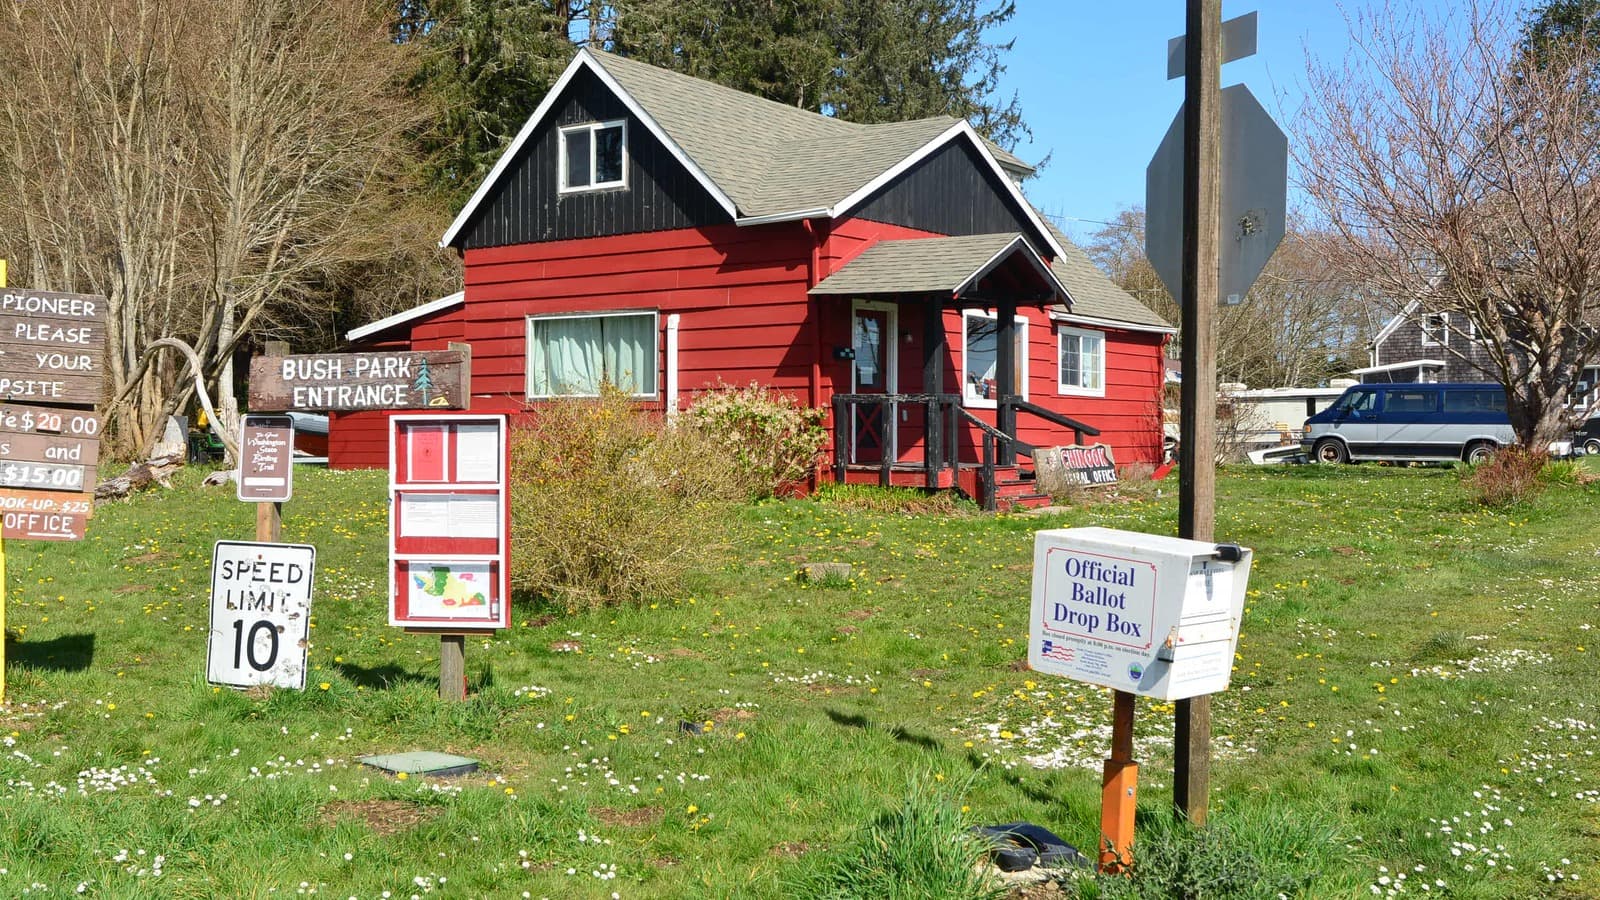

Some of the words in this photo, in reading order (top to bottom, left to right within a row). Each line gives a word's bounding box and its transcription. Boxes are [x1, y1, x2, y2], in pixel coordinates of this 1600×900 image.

[2, 294, 96, 317] PIONEER
[15, 323, 92, 344] PLEASE
[36, 352, 92, 370] YOUR
[282, 358, 342, 381] BUSH
[355, 356, 412, 378] PARK
[293, 384, 409, 408] ENTRANCE
[21, 410, 98, 435] $20.00
[45, 443, 82, 460] and
[247, 437, 286, 447] Washington
[256, 445, 278, 454] State
[251, 453, 278, 463] Birding
[257, 462, 275, 472] Trail
[1060, 447, 1109, 470] CHINOOK
[3, 464, 80, 486] $15.00
[1092, 469, 1117, 483] OFFICE
[62, 500, 90, 513] $25
[4, 513, 73, 533] OFFICE
[221, 559, 303, 584] SPEED
[1065, 557, 1135, 587] Official
[226, 589, 291, 613] LIMIT
[1071, 581, 1126, 610] Ballot
[1053, 602, 1099, 633] Drop
[1106, 612, 1142, 638] Box
[233, 619, 279, 672] 10
